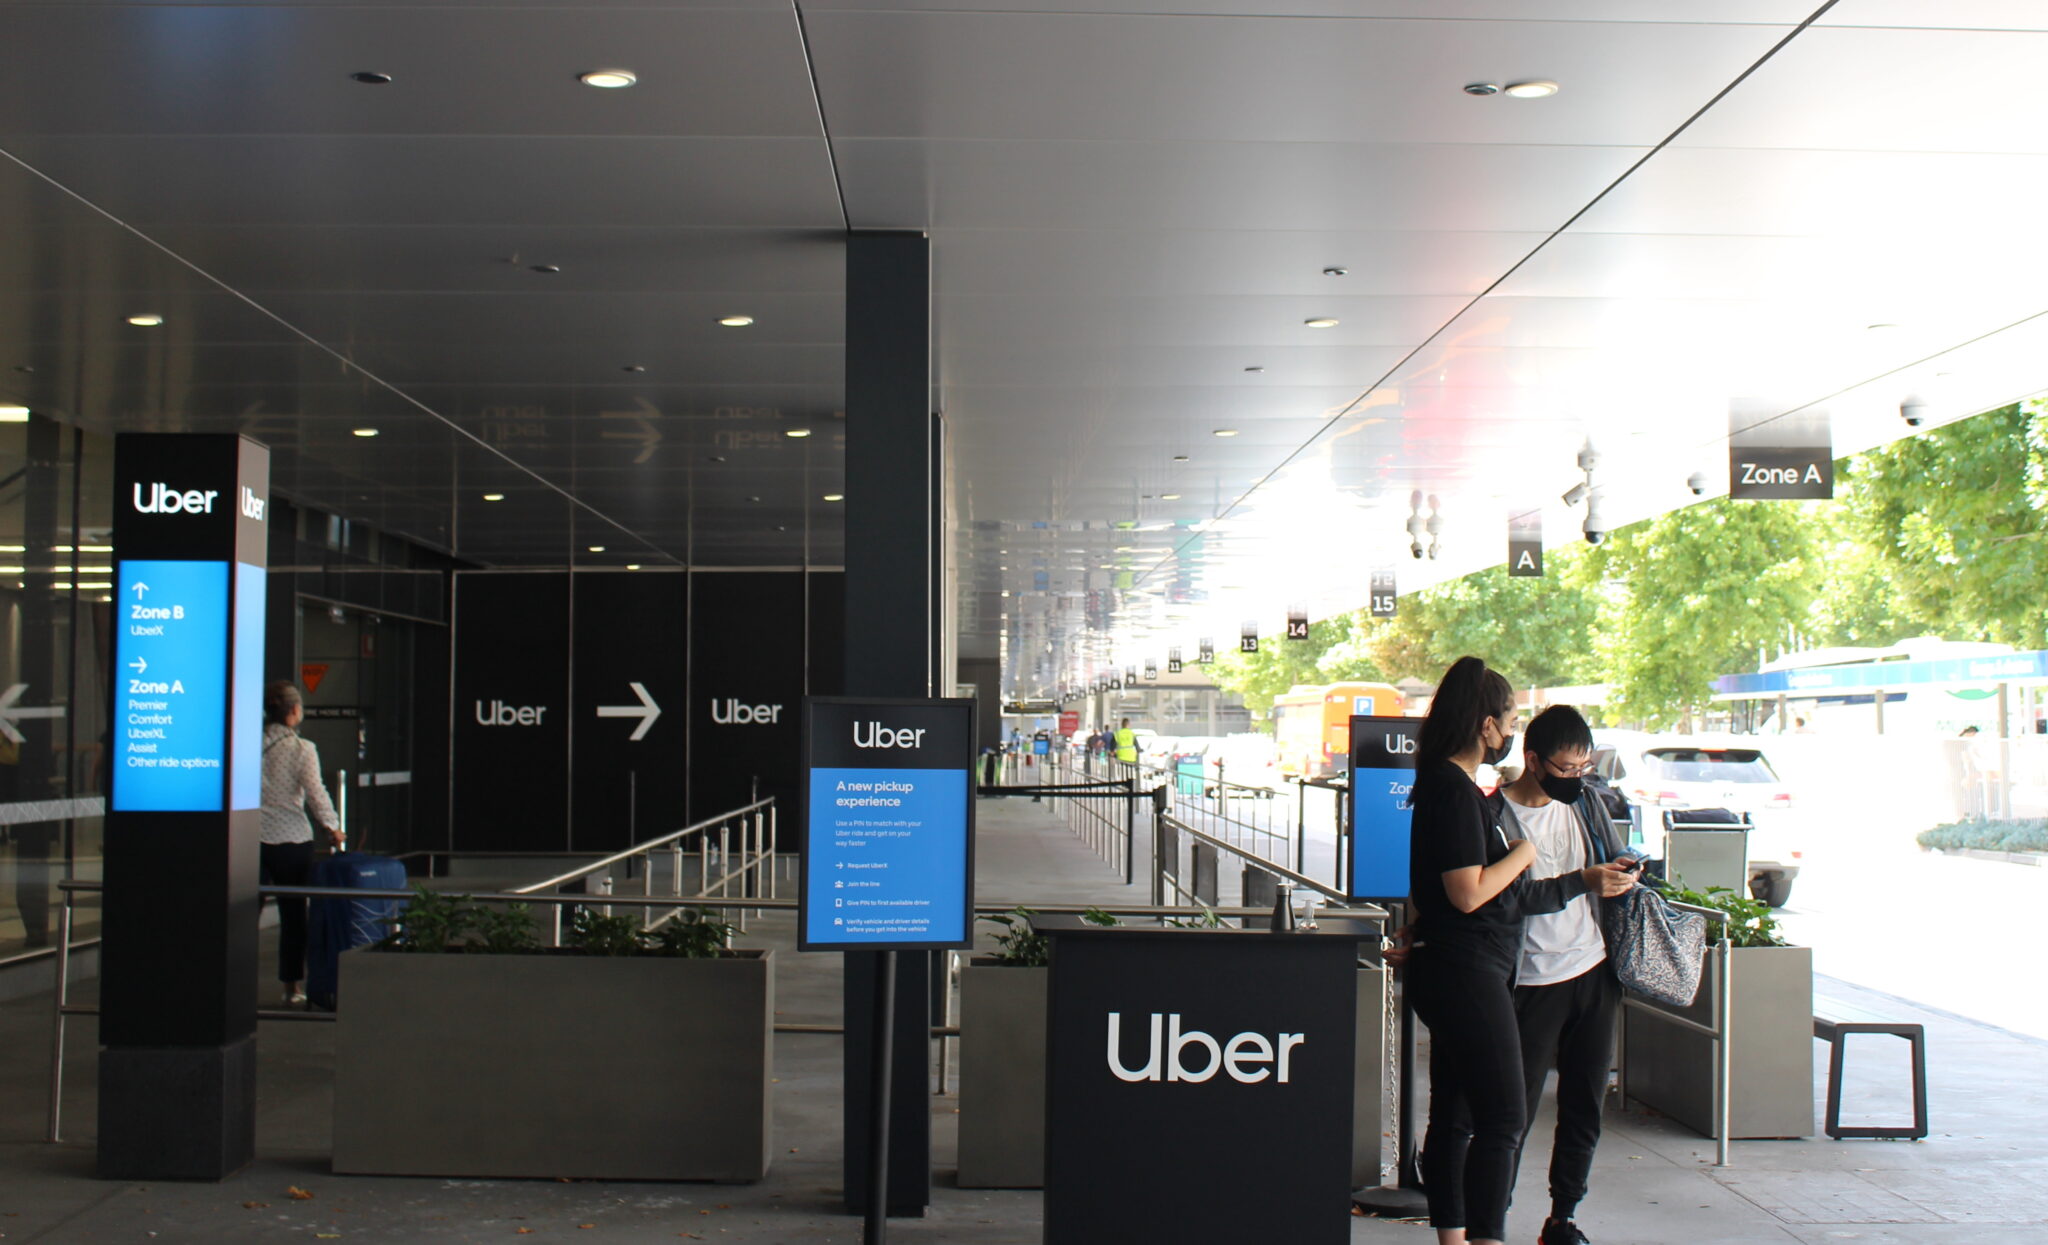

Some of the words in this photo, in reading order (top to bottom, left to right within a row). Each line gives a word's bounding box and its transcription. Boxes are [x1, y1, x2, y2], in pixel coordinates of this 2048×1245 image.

[1741, 463, 1799, 484] Zone
[1803, 463, 1822, 484] A
[134, 482, 218, 514] Uber
[242, 486, 265, 520] Uber
[1516, 550, 1536, 570] A
[1373, 596, 1395, 612] 15
[131, 605, 171, 620] Zone
[173, 605, 184, 619] B
[130, 625, 164, 636] UberX
[1288, 623, 1307, 636] 14
[1242, 638, 1257, 650] 13
[1200, 651, 1213, 663] 12
[1170, 660, 1180, 671] 11
[129, 679, 169, 694] Zone
[171, 679, 185, 694] A
[128, 699, 168, 710] Premier
[711, 699, 782, 724] Uber
[128, 714, 173, 725] Comfort
[475, 700, 546, 725] Uber
[127, 728, 167, 739] UberXL
[853, 721, 925, 748] Uber
[127, 743, 157, 753] Assist
[1385, 733, 1416, 754] Ub
[127, 757, 157, 767] Other
[159, 757, 180, 767] ride
[181, 757, 219, 769] options
[836, 781, 847, 791] A
[848, 783, 872, 791] new
[875, 781, 914, 794] pickup
[836, 796, 901, 808] experience
[1107, 1012, 1305, 1084] Uber
